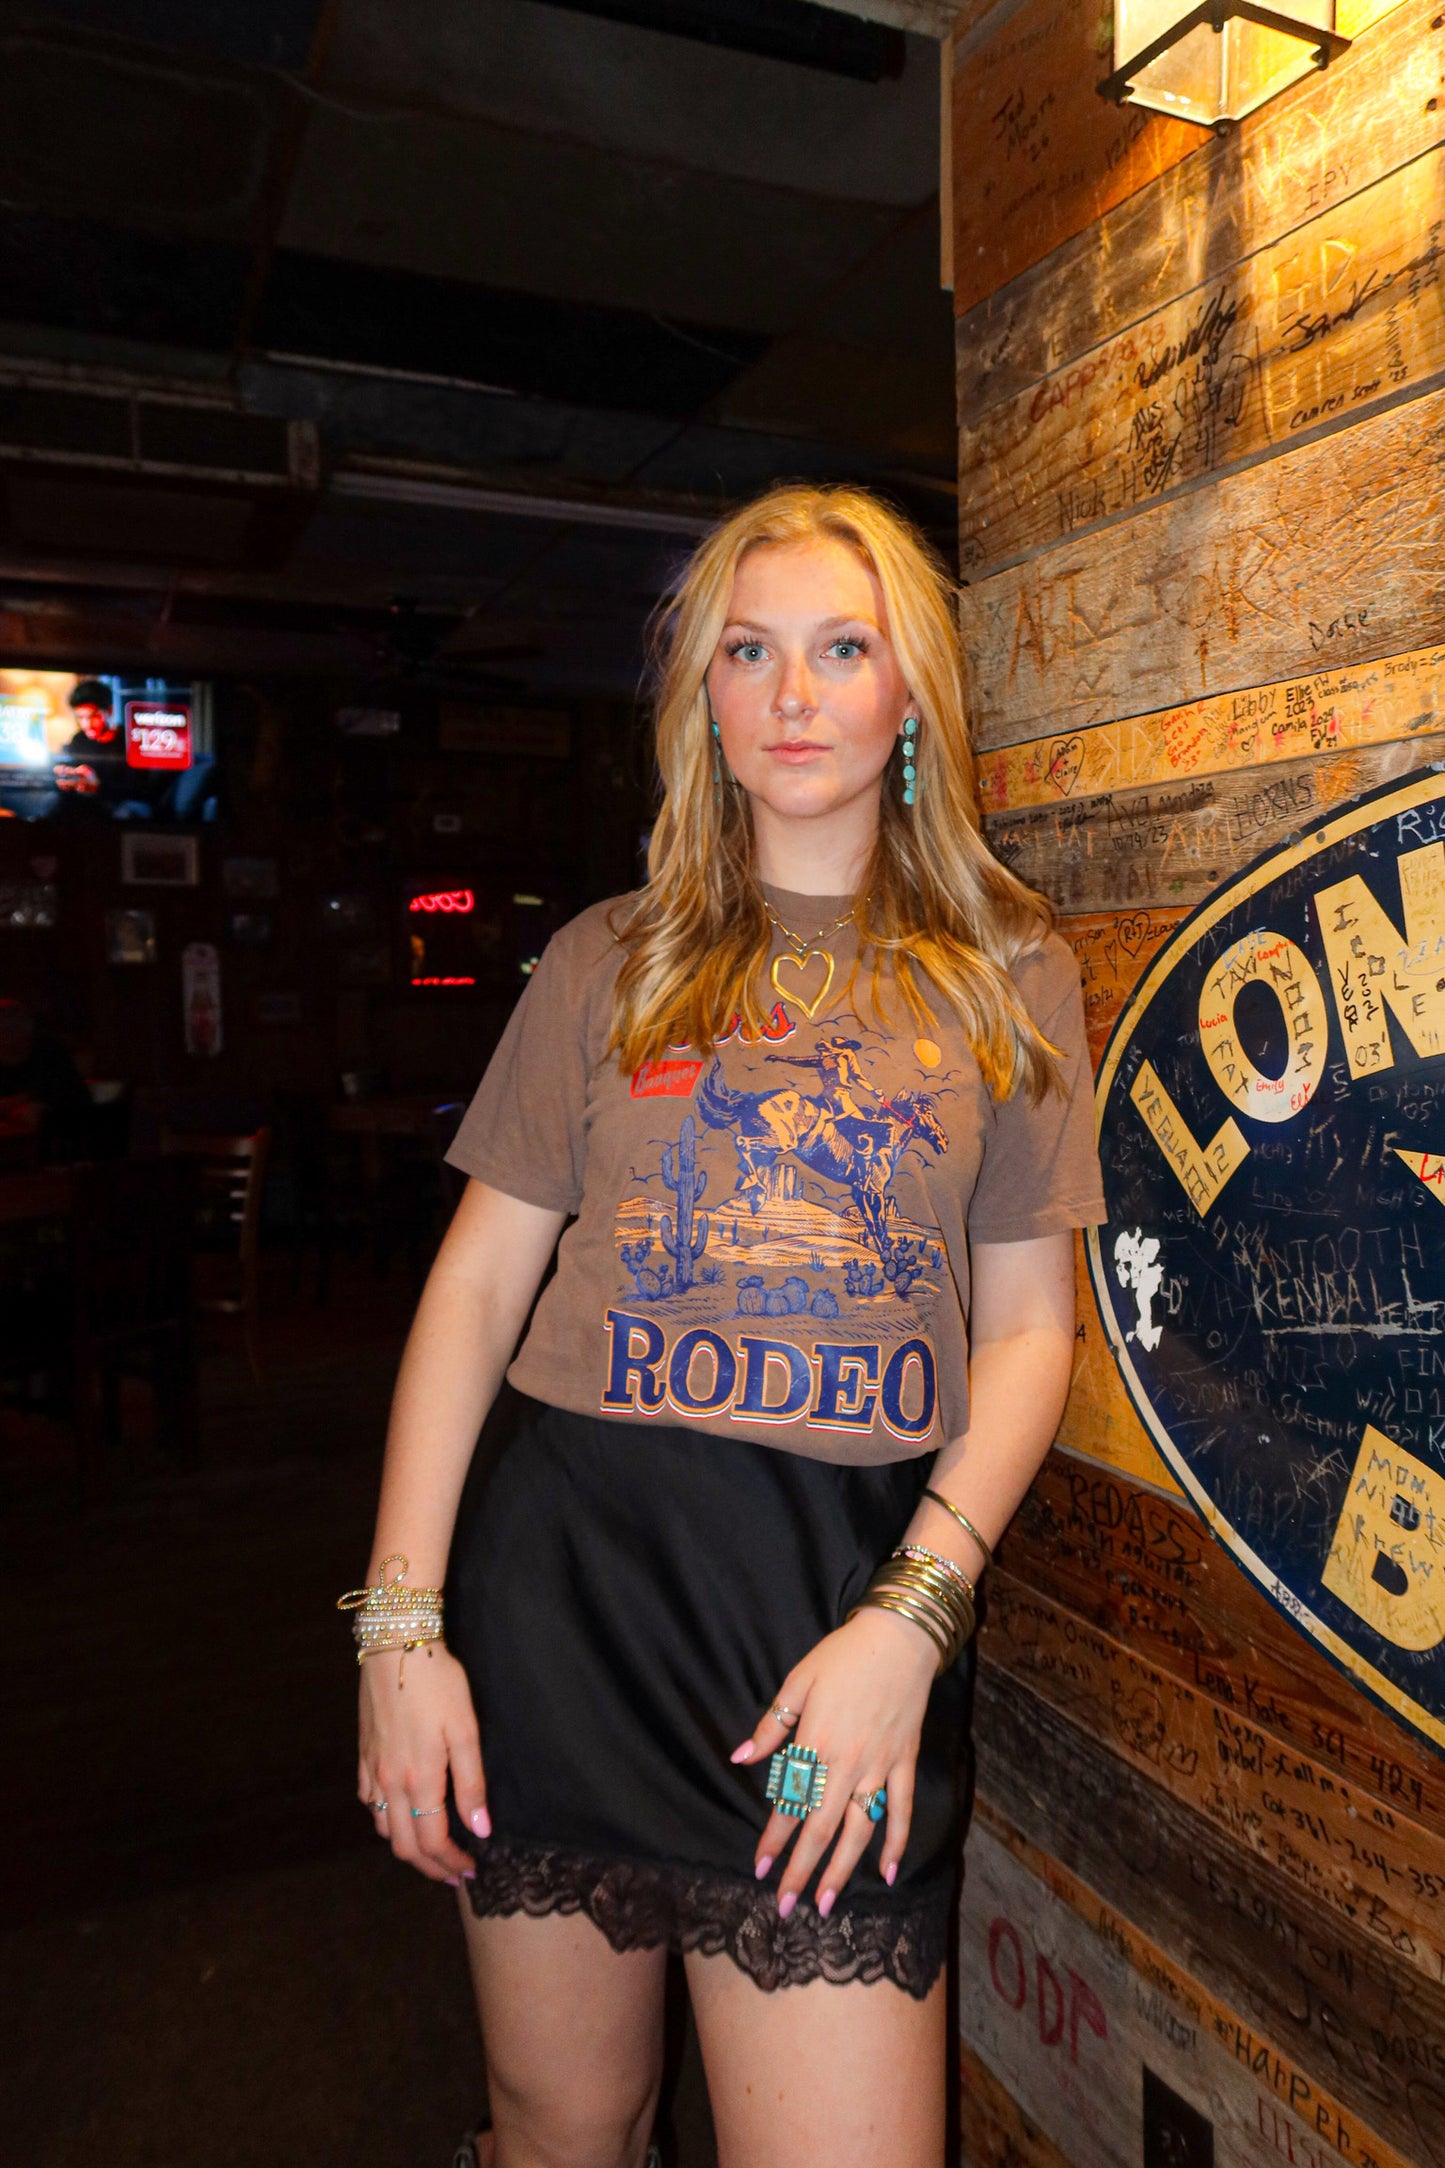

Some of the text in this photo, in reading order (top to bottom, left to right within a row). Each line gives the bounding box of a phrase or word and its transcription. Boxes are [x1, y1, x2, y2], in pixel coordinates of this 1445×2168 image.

[1285, 697, 1315, 718] 2023
[634, 1062, 698, 1095] Banquet
[599, 1307, 939, 1444] RODEO
